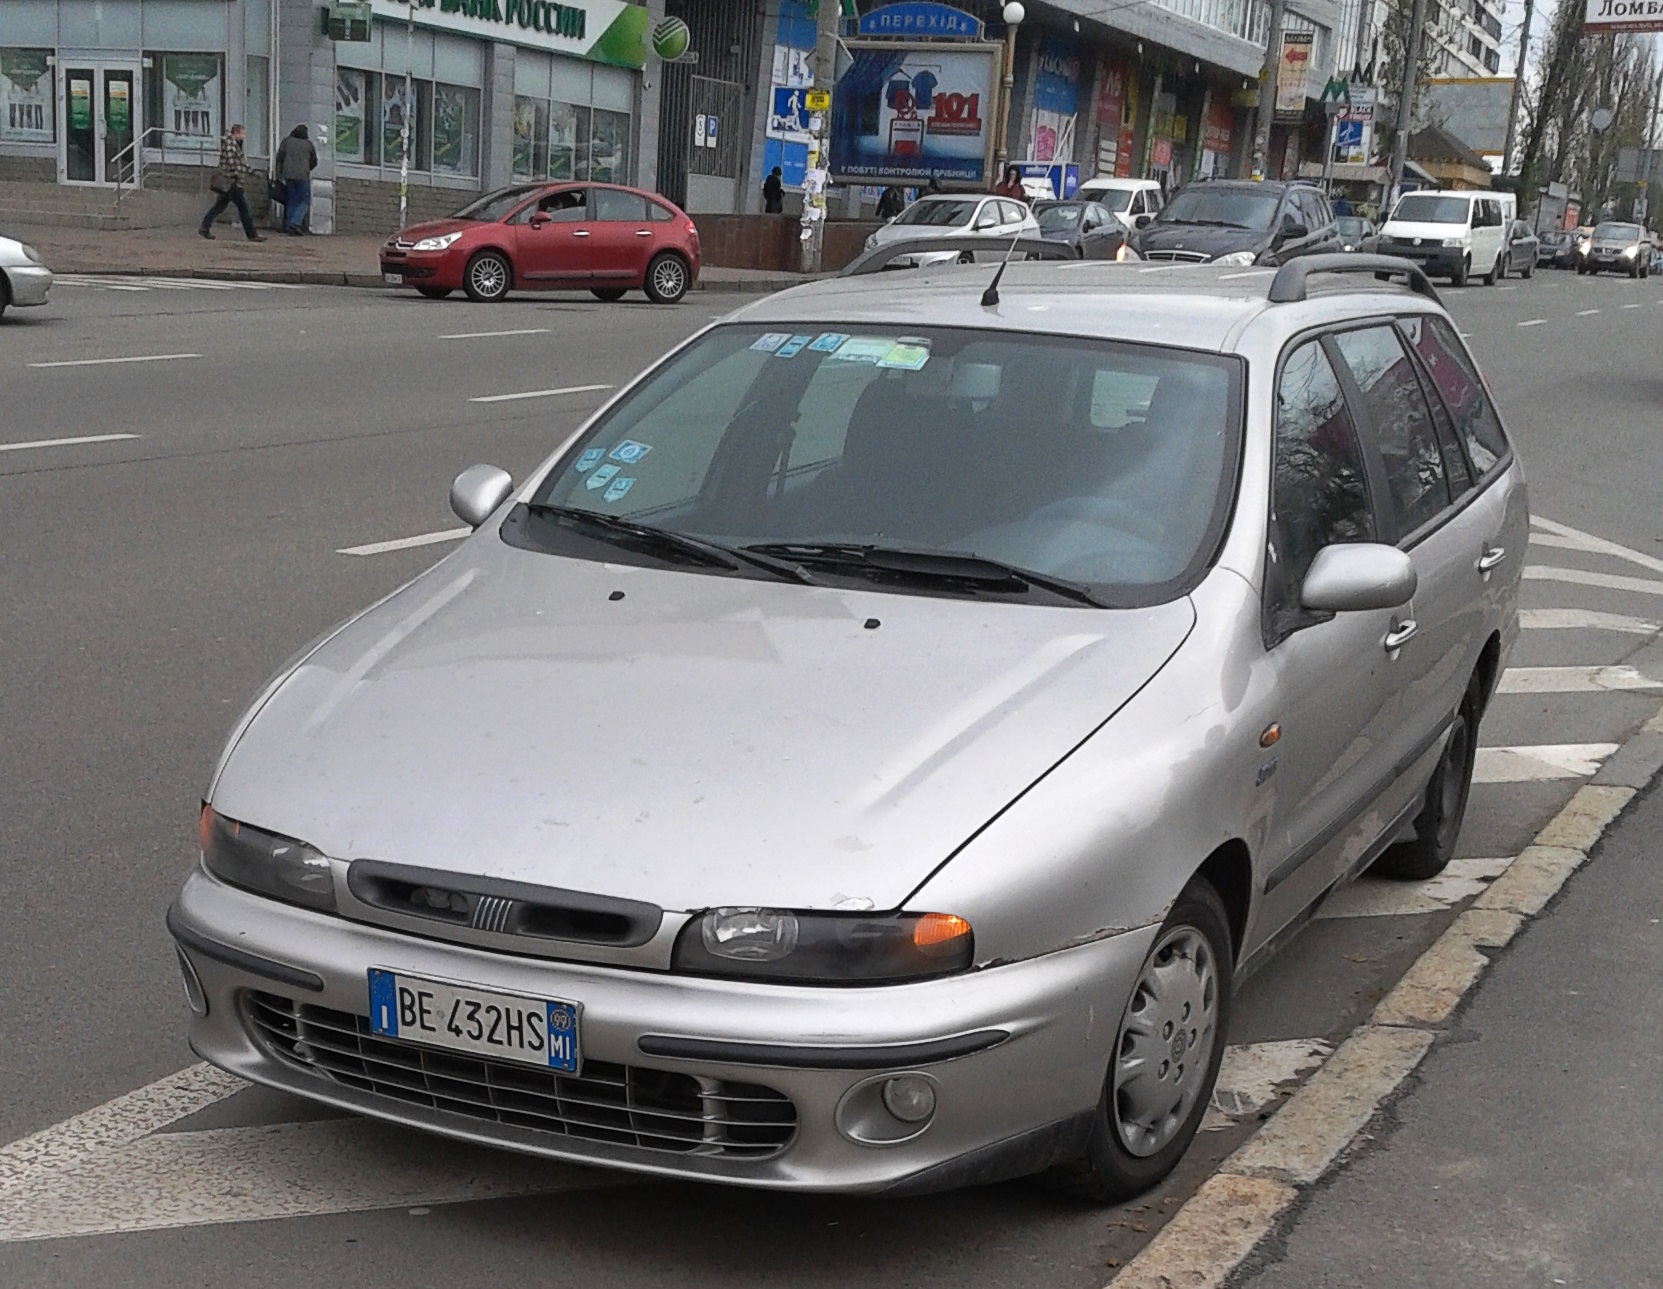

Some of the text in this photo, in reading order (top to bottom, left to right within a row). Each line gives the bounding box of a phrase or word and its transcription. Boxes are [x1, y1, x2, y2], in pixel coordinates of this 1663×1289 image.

[505, 0, 587, 40] РОССИИ
[1598, 0, 1663, 16] ЛОМБ
[880, 15, 957, 30] ПЕРЕХІД
[932, 91, 979, 119] 101
[399, 987, 437, 1032] BE
[447, 998, 545, 1051] 432HS
[553, 1013, 568, 1026] 99
[550, 1033, 571, 1061] MI
